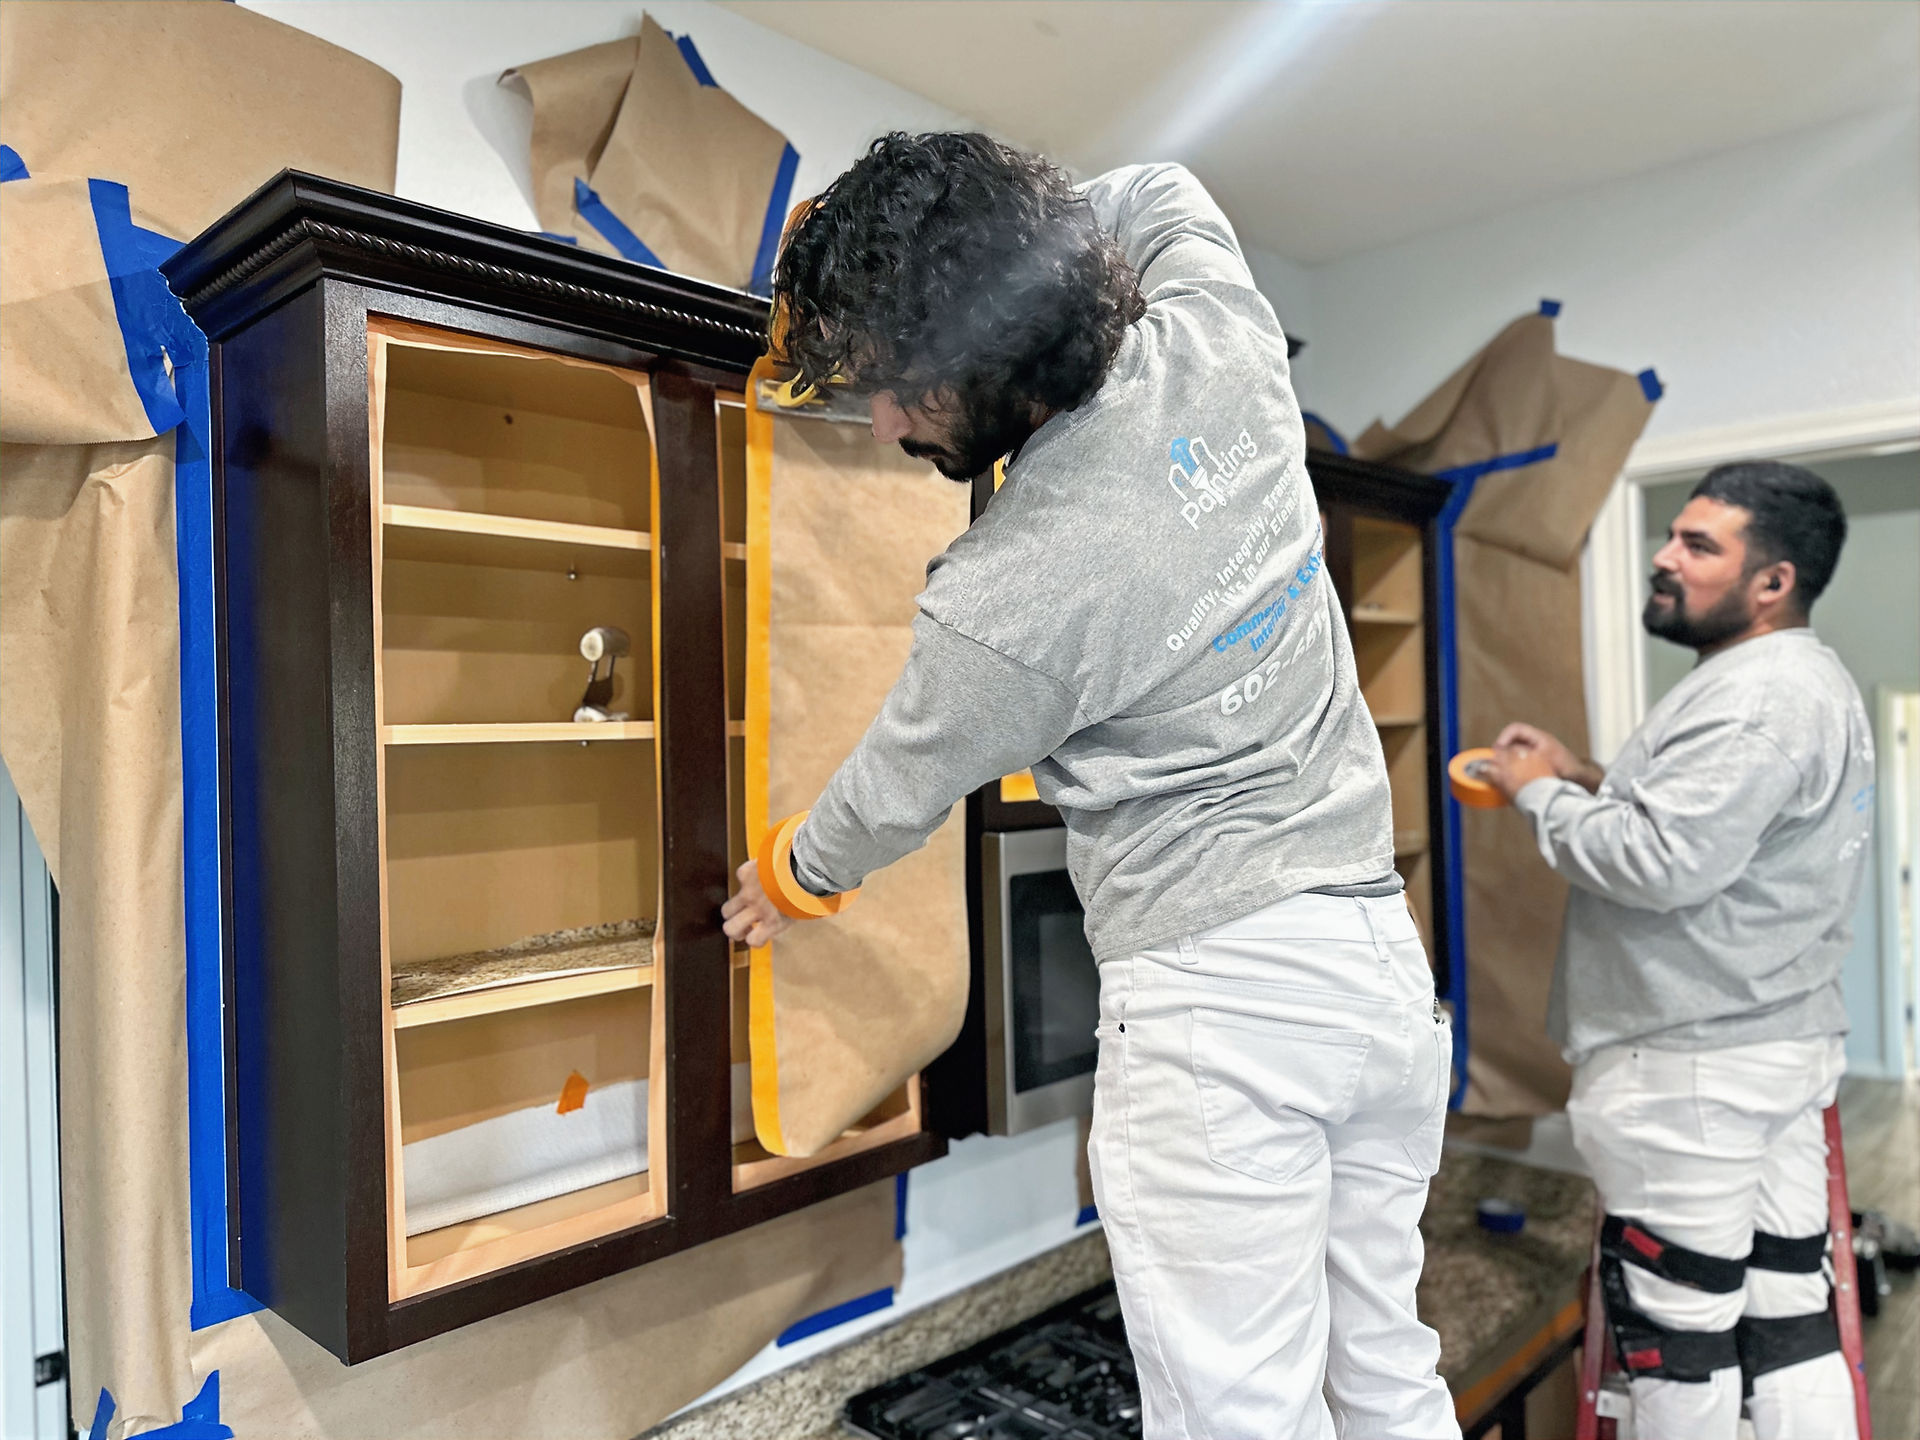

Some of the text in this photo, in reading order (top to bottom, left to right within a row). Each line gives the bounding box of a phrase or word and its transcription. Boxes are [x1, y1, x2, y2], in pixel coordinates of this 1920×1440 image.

[1166, 589, 1219, 651] Quality,
[1216, 516, 1269, 585] Integrity,
[1241, 563, 1257, 583] in
[1255, 534, 1271, 564] our
[1250, 597, 1286, 652] Interior
